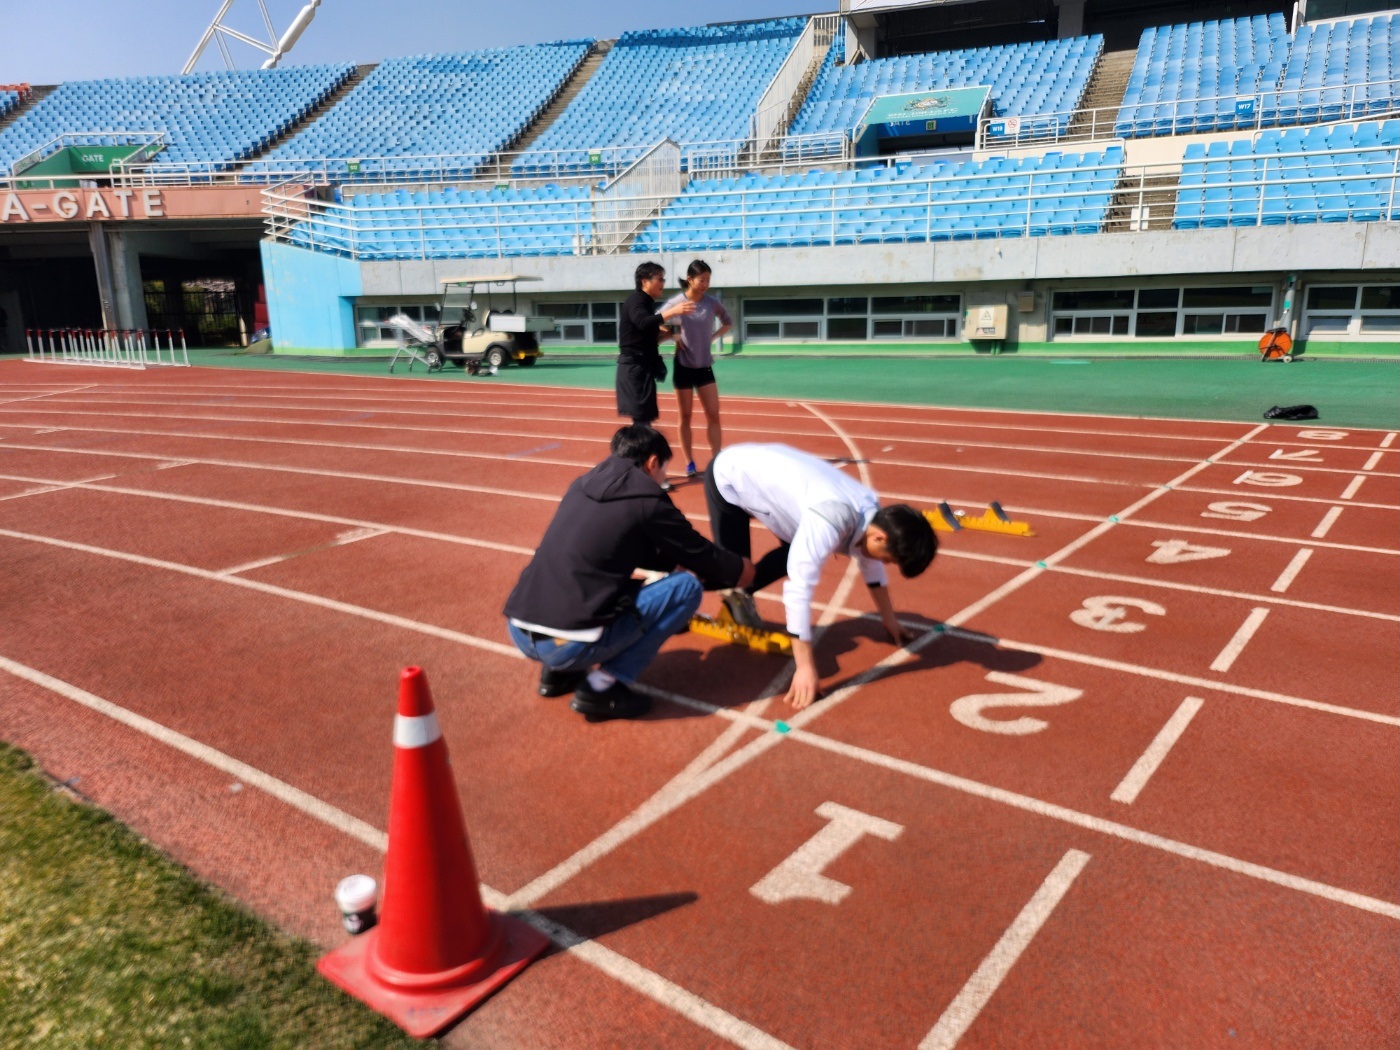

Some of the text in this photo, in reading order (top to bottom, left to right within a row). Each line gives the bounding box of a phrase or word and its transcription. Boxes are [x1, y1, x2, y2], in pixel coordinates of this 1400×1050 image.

[82, 154, 104, 163] GATE
[3, 190, 164, 221] A-GATE
[1268, 449, 1324, 462] 7
[1232, 470, 1303, 487] 6
[1200, 502, 1273, 522] 5
[1145, 538, 1232, 564] 4
[1069, 595, 1166, 633] 3
[949, 671, 1083, 735] 2
[749, 801, 904, 905] 1
